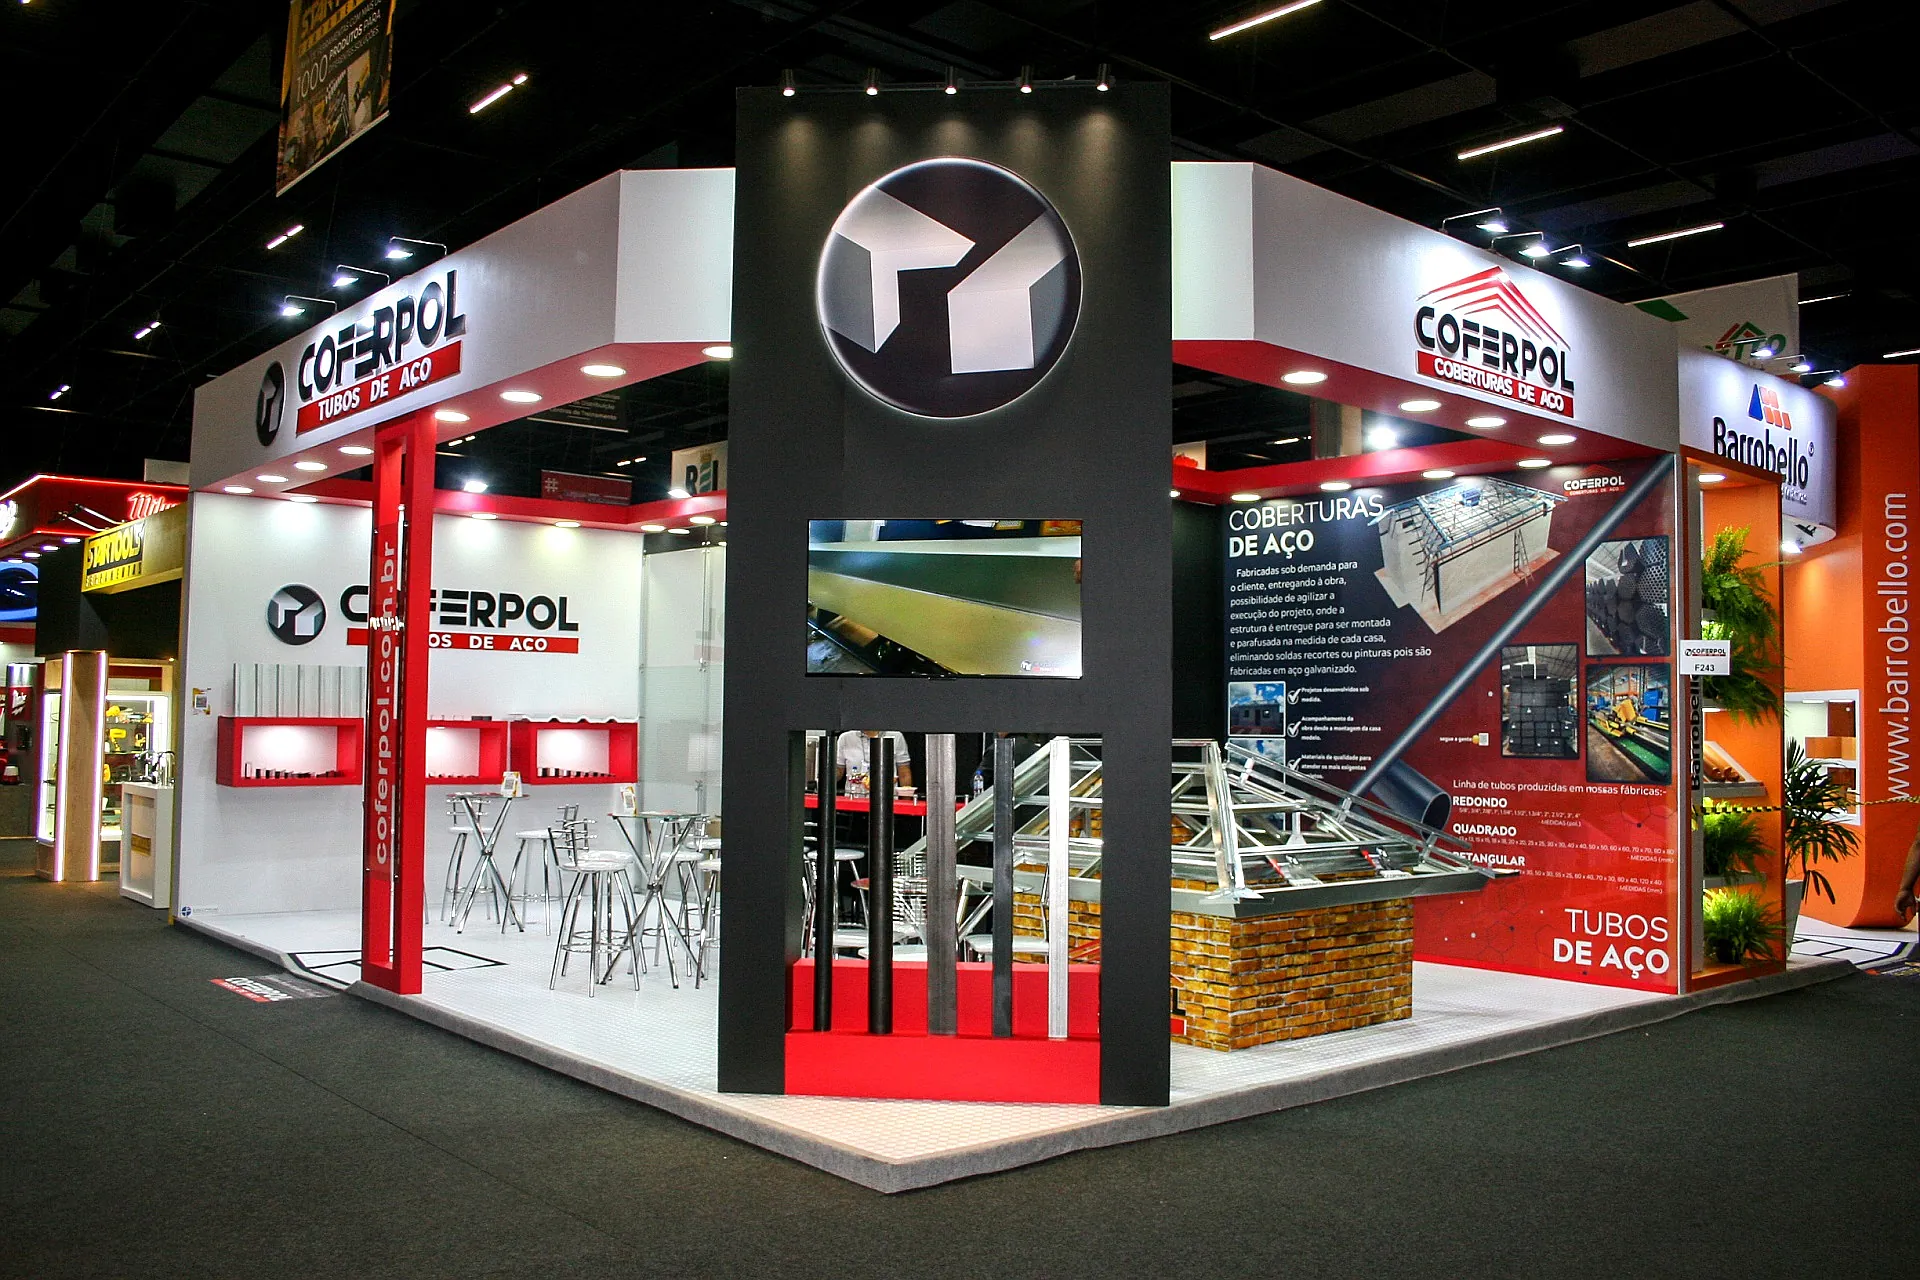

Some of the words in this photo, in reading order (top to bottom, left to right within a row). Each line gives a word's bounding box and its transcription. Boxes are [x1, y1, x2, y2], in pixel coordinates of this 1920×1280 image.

[329, 23, 363, 60] PRODUTOS
[298, 269, 466, 402] COFERPOL
[1414, 305, 1575, 394] COFERPOL
[1434, 357, 1513, 396] COBERTURAS
[1518, 382, 1535, 403] DE
[318, 387, 361, 421] TUBOS
[370, 375, 389, 402] DE
[399, 357, 432, 391] AÇO
[1713, 416, 1809, 489] Barrobello
[1563, 476, 1625, 491] COFERPOL
[1229, 494, 1384, 531] COBERTURAS
[87, 521, 145, 569] STARTOOLS
[1229, 535, 1258, 558] DE
[1263, 529, 1314, 559] AÇO
[1236, 566, 1280, 578] Fabricadas
[1280, 564, 1296, 574] sob
[1297, 561, 1336, 573] demanda
[1338, 561, 1358, 572] para
[1237, 582, 1267, 592] cliente,
[1268, 577, 1316, 591] entregando
[1324, 575, 1347, 586] obra,
[1230, 594, 1283, 607] possibilidade
[1285, 593, 1295, 602] de
[1297, 591, 1328, 604] agilizar
[1329, 592, 1335, 600] a
[1230, 609, 1267, 621] execução
[1268, 608, 1279, 618] do
[1281, 607, 1314, 619] projeto,
[1316, 605, 1338, 616] onde
[1339, 606, 1345, 614] a
[1230, 625, 1267, 634] estrutura
[1268, 623, 1274, 632] é
[1275, 623, 1313, 633] entregue
[1315, 621, 1334, 631] para
[1335, 621, 1349, 629] ser
[1351, 617, 1391, 628] montada
[469, 636, 494, 650] DE
[509, 637, 548, 652] AÇO
[1230, 640, 1235, 648] e
[1236, 637, 1281, 649] parafusada
[1282, 638, 1293, 646] na
[1294, 635, 1326, 645] medida
[1328, 635, 1339, 644] de
[1340, 633, 1362, 643] cada
[1363, 634, 1386, 643] casa,
[1878, 492, 1910, 801] www.barrobello.com
[1230, 651, 1274, 661] eliminando
[1276, 651, 1302, 661] soldas
[1303, 651, 1340, 660] recortes
[1341, 650, 1353, 658] ou
[1354, 648, 1391, 660] pinturas
[1393, 646, 1413, 658] pois
[1415, 645, 1432, 656] são
[1229, 666, 1271, 676] fabricadas
[1273, 667, 1286, 675] em
[1287, 667, 1303, 677] aço
[1304, 664, 1357, 677] galvanizado.
[1694, 664, 1715, 672] F243
[375, 542, 399, 864] coferpol.com.br
[1453, 779, 1476, 789] Linha
[1477, 781, 1489, 789] de
[1490, 781, 1515, 791] tubos
[1517, 783, 1567, 795] produzidas
[1569, 785, 1584, 793] em
[1586, 786, 1618, 795] nossas
[1452, 795, 1508, 808] REDONDO
[1452, 823, 1517, 837] QUADRADO
[1564, 907, 1669, 942] TUBOS
[1553, 938, 1592, 965] DE
[1600, 944, 1670, 979] AÇO
